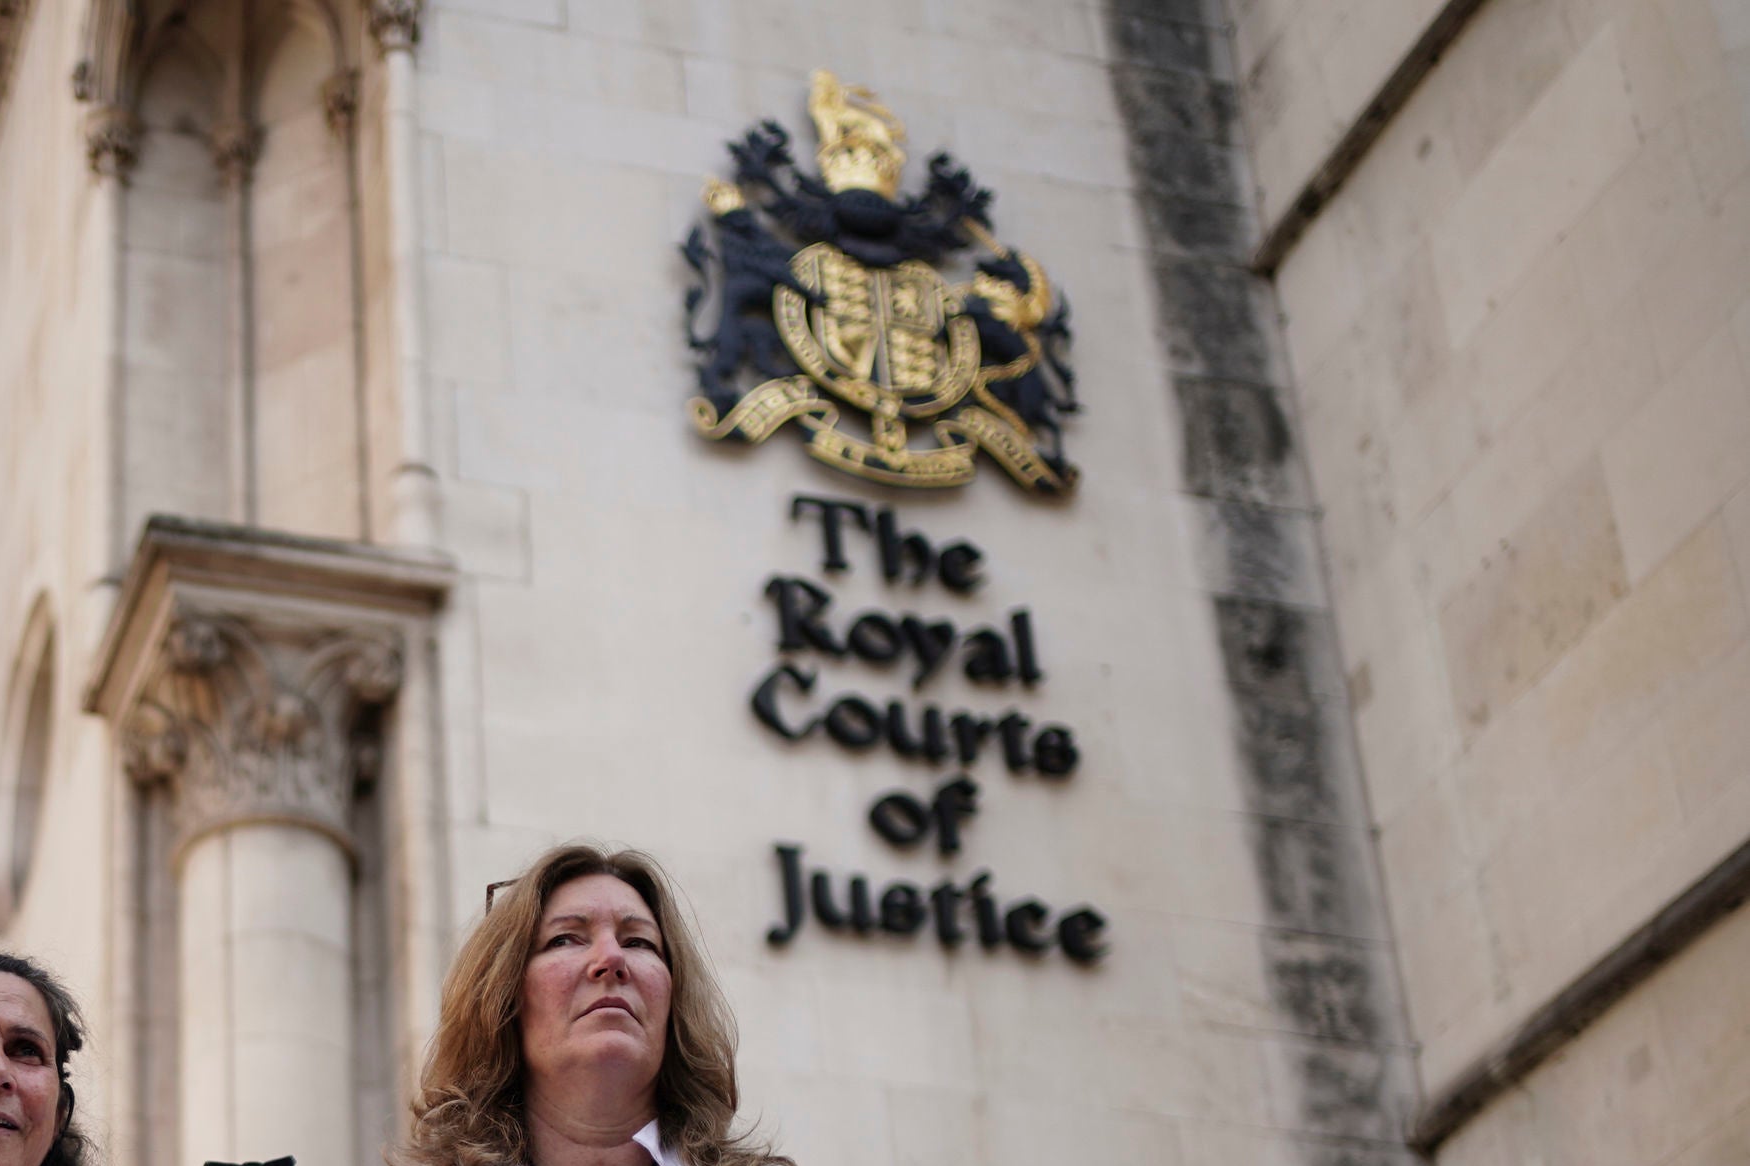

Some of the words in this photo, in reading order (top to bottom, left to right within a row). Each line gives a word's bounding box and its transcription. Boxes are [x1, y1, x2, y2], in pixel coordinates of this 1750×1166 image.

[791, 496, 985, 593] The
[764, 576, 1043, 686] Royal
[750, 663, 1078, 778] Courts
[869, 774, 980, 853] of
[766, 843, 1113, 965] Justice
